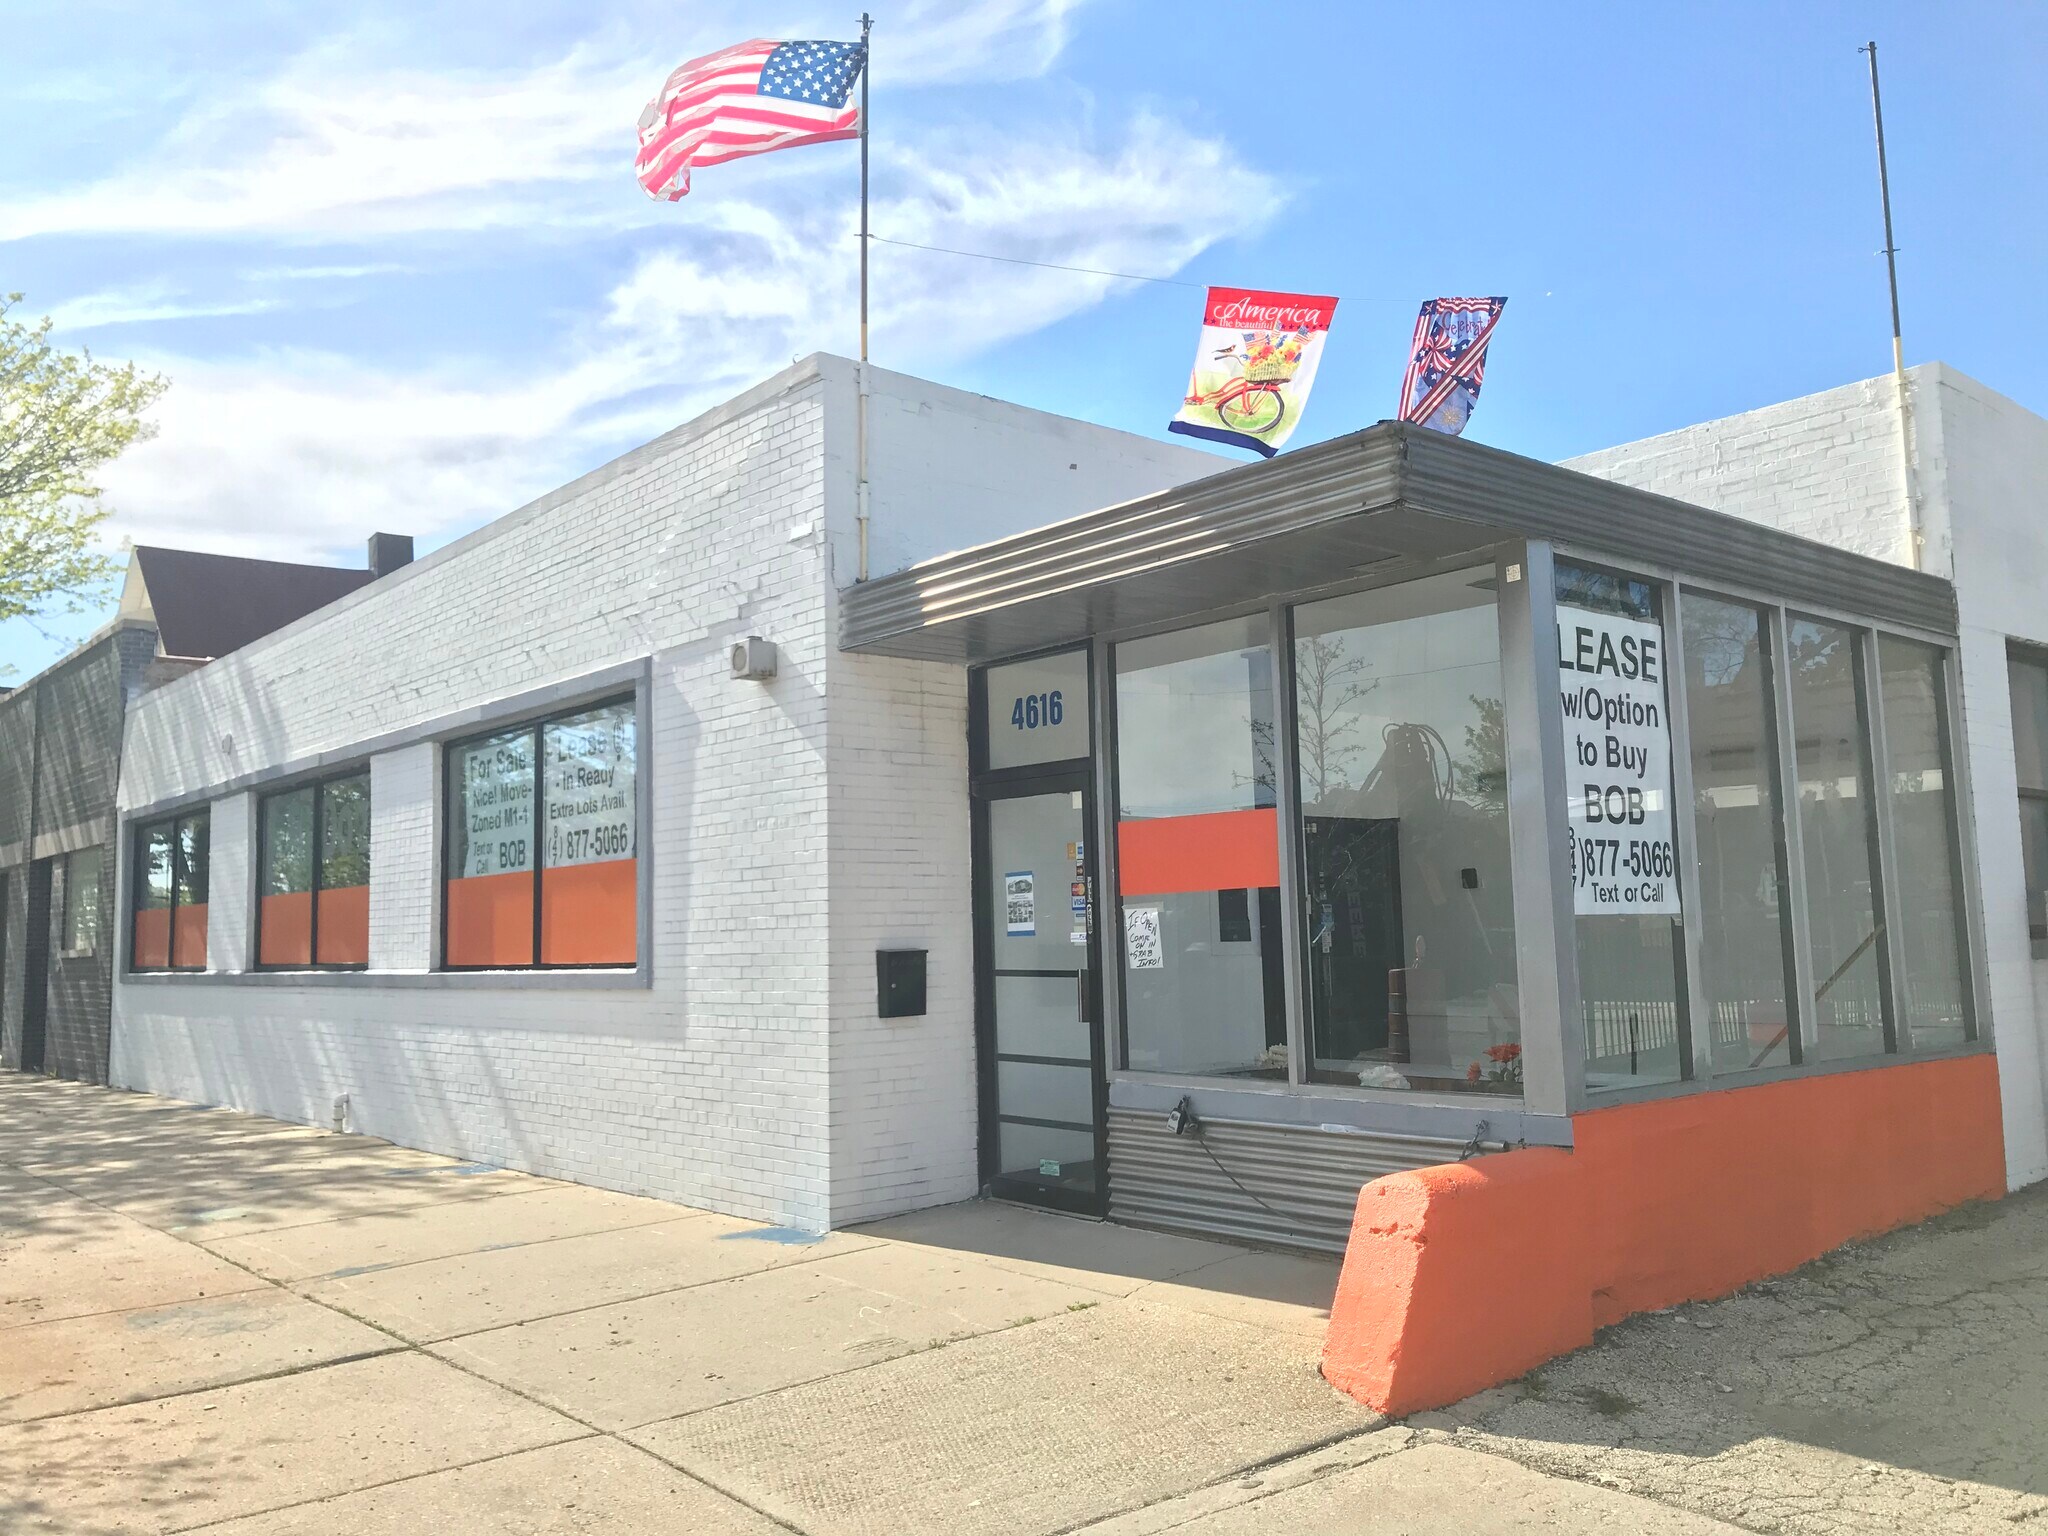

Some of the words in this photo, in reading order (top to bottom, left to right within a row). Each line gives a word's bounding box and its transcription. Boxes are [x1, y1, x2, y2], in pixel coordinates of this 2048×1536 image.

[1213, 296, 1321, 324] America
[1235, 318, 1273, 330] beautiful
[1442, 311, 1486, 337] Celebrat
[1556, 623, 1658, 684] LEASE
[1011, 690, 1063, 730] 4616
[1560, 686, 1659, 731] w/Option
[470, 755, 492, 781] For
[496, 749, 527, 775] Sale
[1576, 733, 1598, 767] to
[1605, 735, 1648, 779] Buy
[473, 785, 497, 808] Nice!
[500, 782, 532, 803] Move-
[550, 802, 574, 820] Extra
[576, 797, 598, 816] Lots
[600, 790, 628, 812] Avail.
[1583, 783, 1645, 825] BOB
[472, 810, 501, 833] Zoned
[499, 839, 526, 869] BOB
[566, 822, 628, 860] 877-5066
[1584, 838, 1673, 878] 877-5066
[1073, 898, 1085, 906] VISA
[1591, 882, 1620, 903] Text
[1624, 887, 1638, 903] or
[1640, 882, 1664, 903] Call
[1148, 938, 1157, 948] IN
